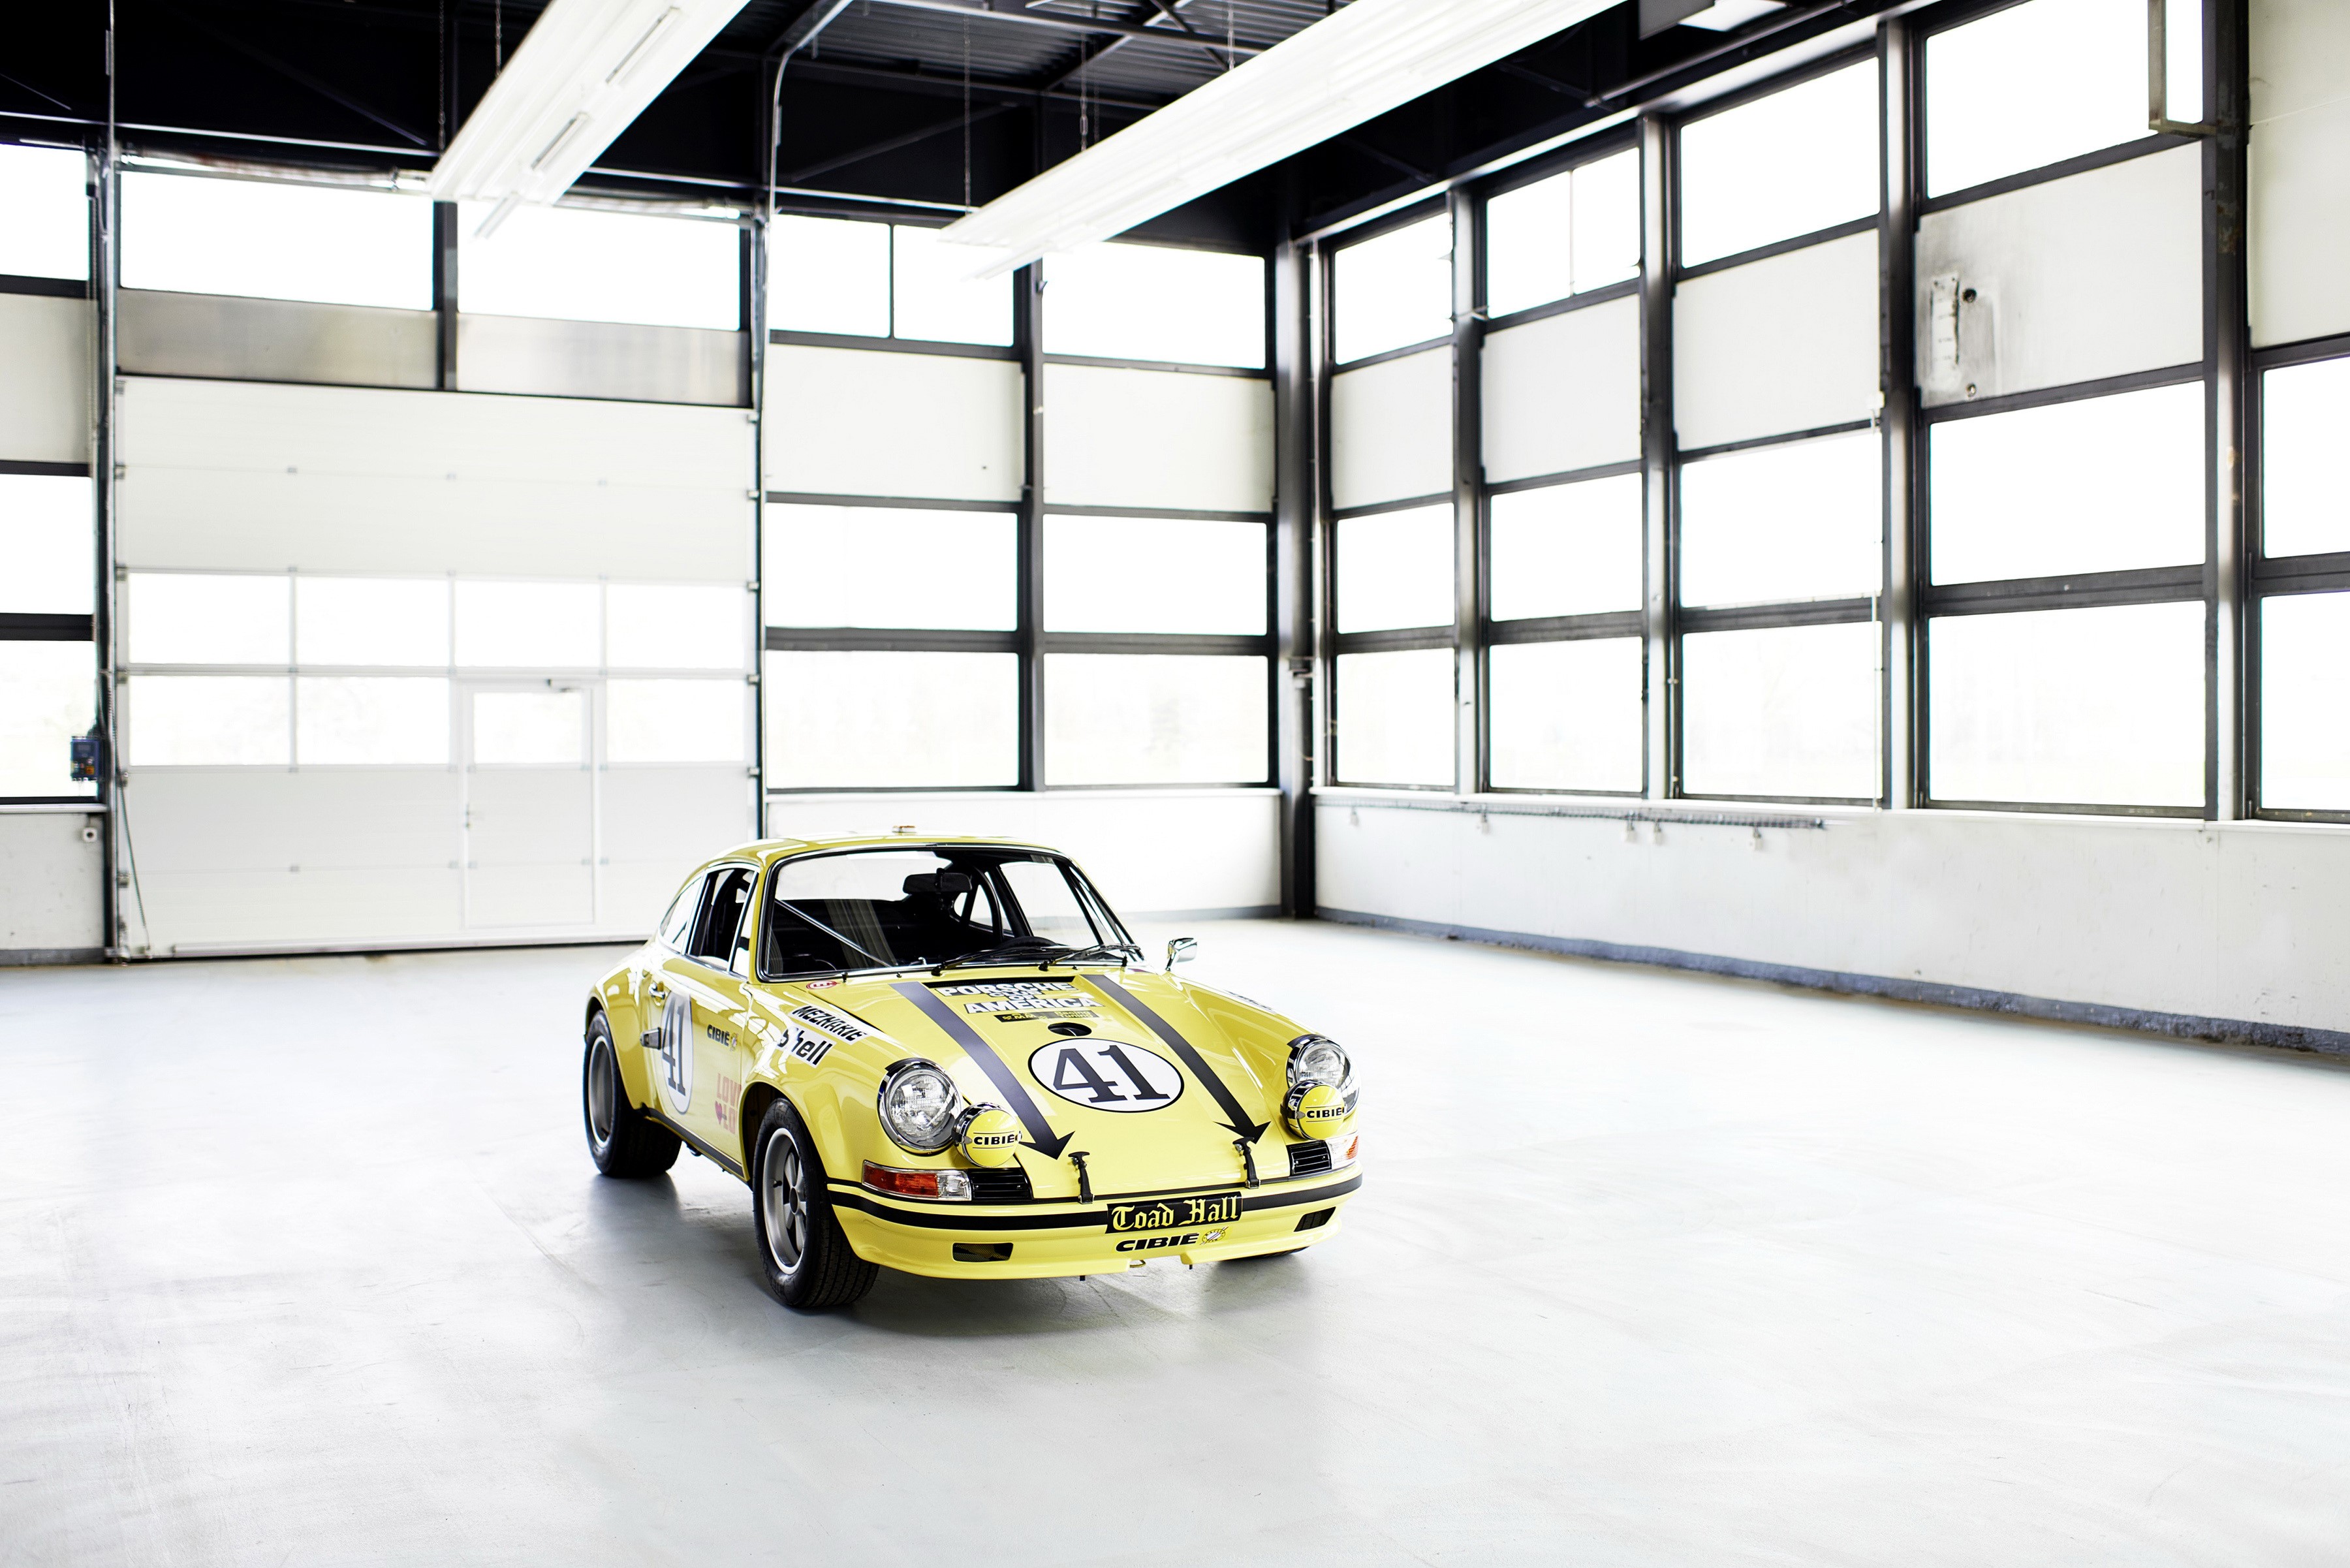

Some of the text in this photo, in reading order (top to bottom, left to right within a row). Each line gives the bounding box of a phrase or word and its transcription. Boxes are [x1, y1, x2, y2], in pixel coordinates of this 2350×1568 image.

[937, 982, 1078, 996] PORSCHE
[966, 997, 1104, 1014] AMERICA
[662, 996, 686, 1097] 41
[1053, 1044, 1171, 1103] 41
[1111, 1195, 1238, 1231] Toad Hall
